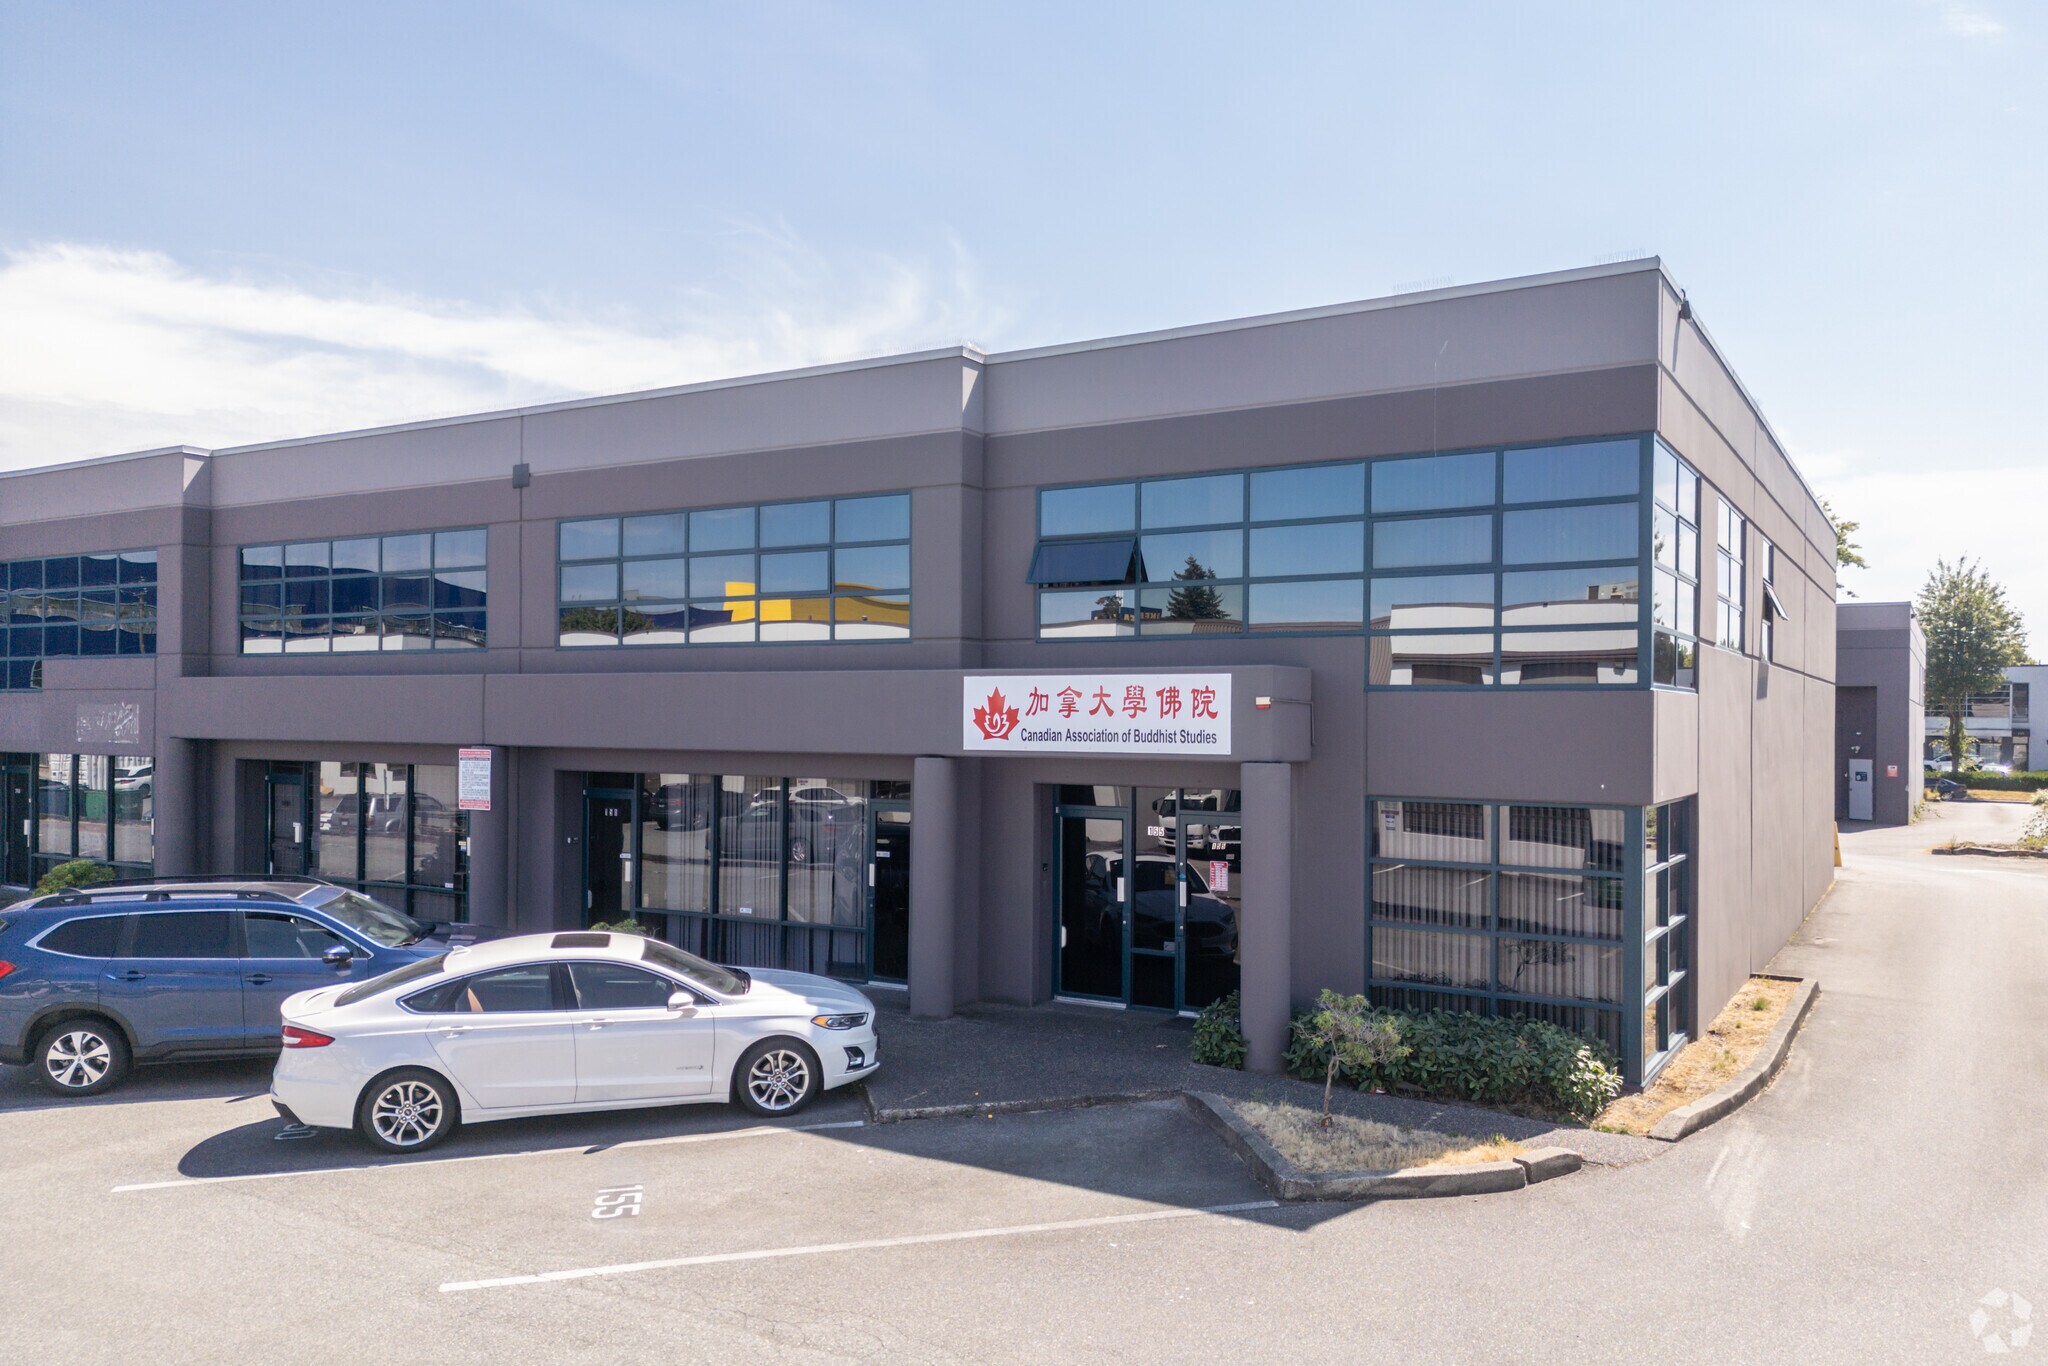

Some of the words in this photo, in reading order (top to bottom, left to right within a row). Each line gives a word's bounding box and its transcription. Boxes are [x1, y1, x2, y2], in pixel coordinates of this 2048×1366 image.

[1025, 685, 1218, 719] 加拿大學佛院
[1020, 728, 1062, 742] Canadian
[1065, 728, 1119, 743] Association
[1121, 729, 1132, 743] of
[1133, 729, 1177, 744] Buddhist
[1180, 729, 1217, 744] Studies
[1148, 826, 1164, 836] 155
[591, 1184, 643, 1219] 155
